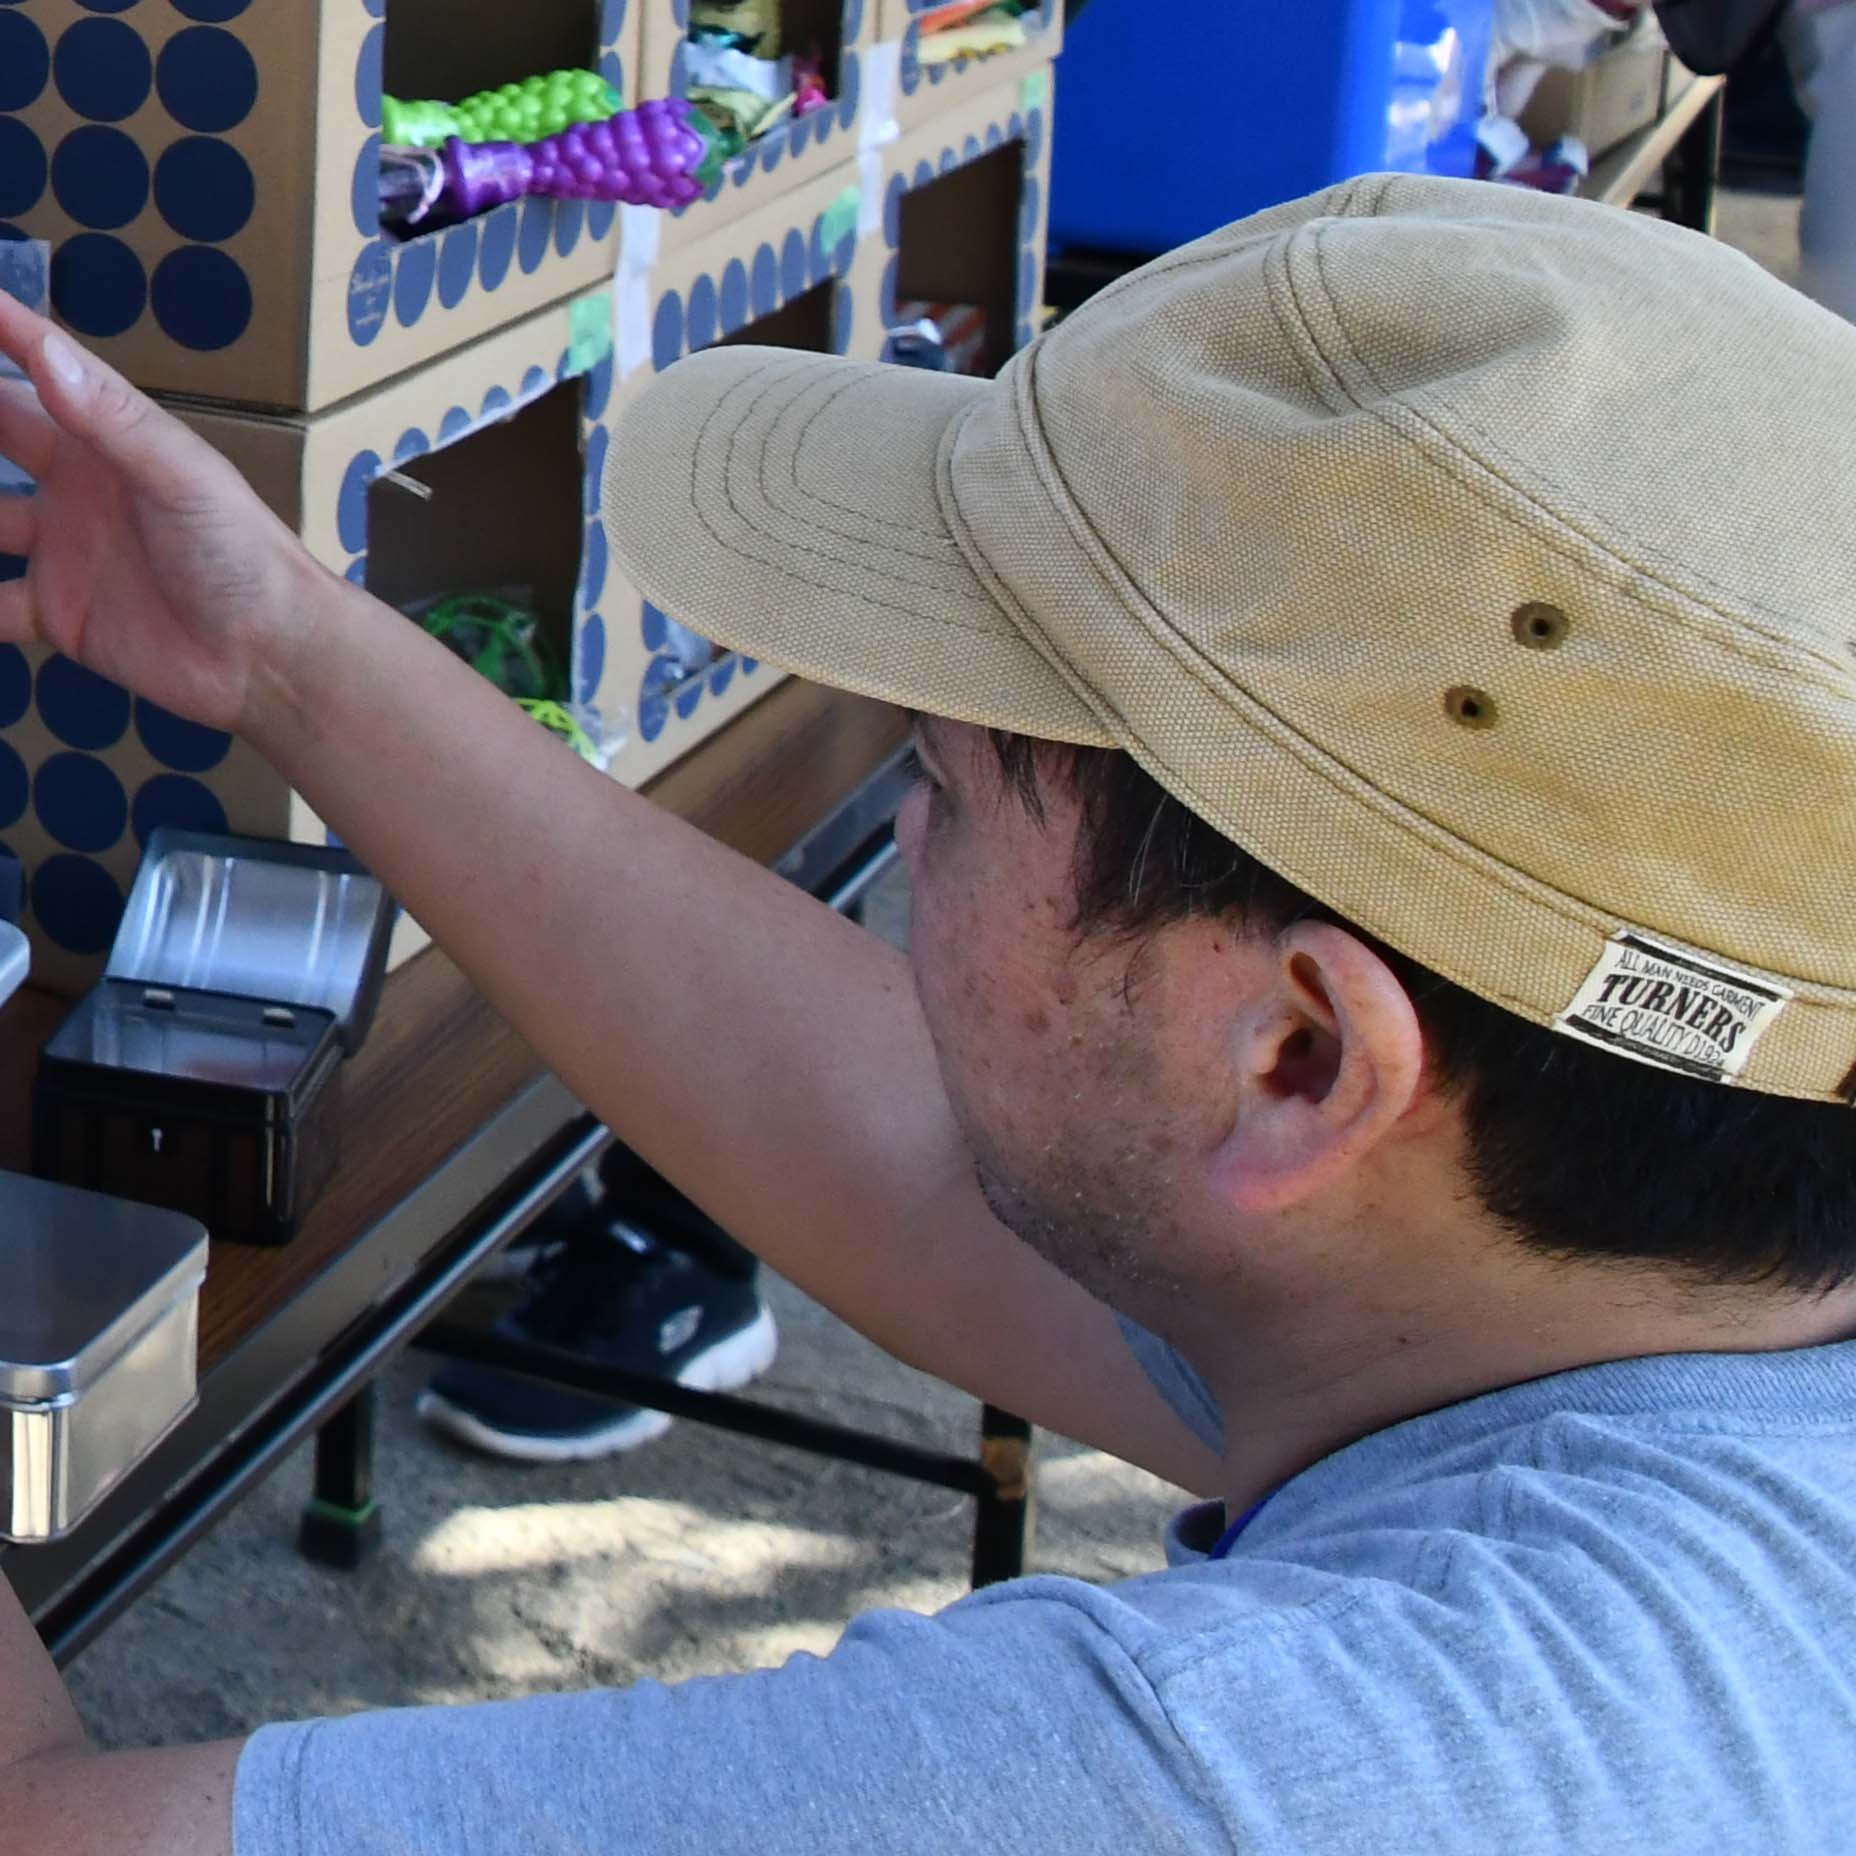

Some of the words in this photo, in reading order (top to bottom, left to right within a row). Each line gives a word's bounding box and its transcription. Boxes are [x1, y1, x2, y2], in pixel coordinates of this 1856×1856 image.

[1596, 972, 1747, 1054] TURNERS
[1615, 948, 1638, 972] ALL
[1642, 959, 1673, 980] MAN
[1675, 970, 1709, 993] NEEDS
[1711, 983, 1766, 1021] GARMENT
[1582, 1004, 1624, 1028] FINE
[1620, 1009, 1688, 1050] QUALITY
